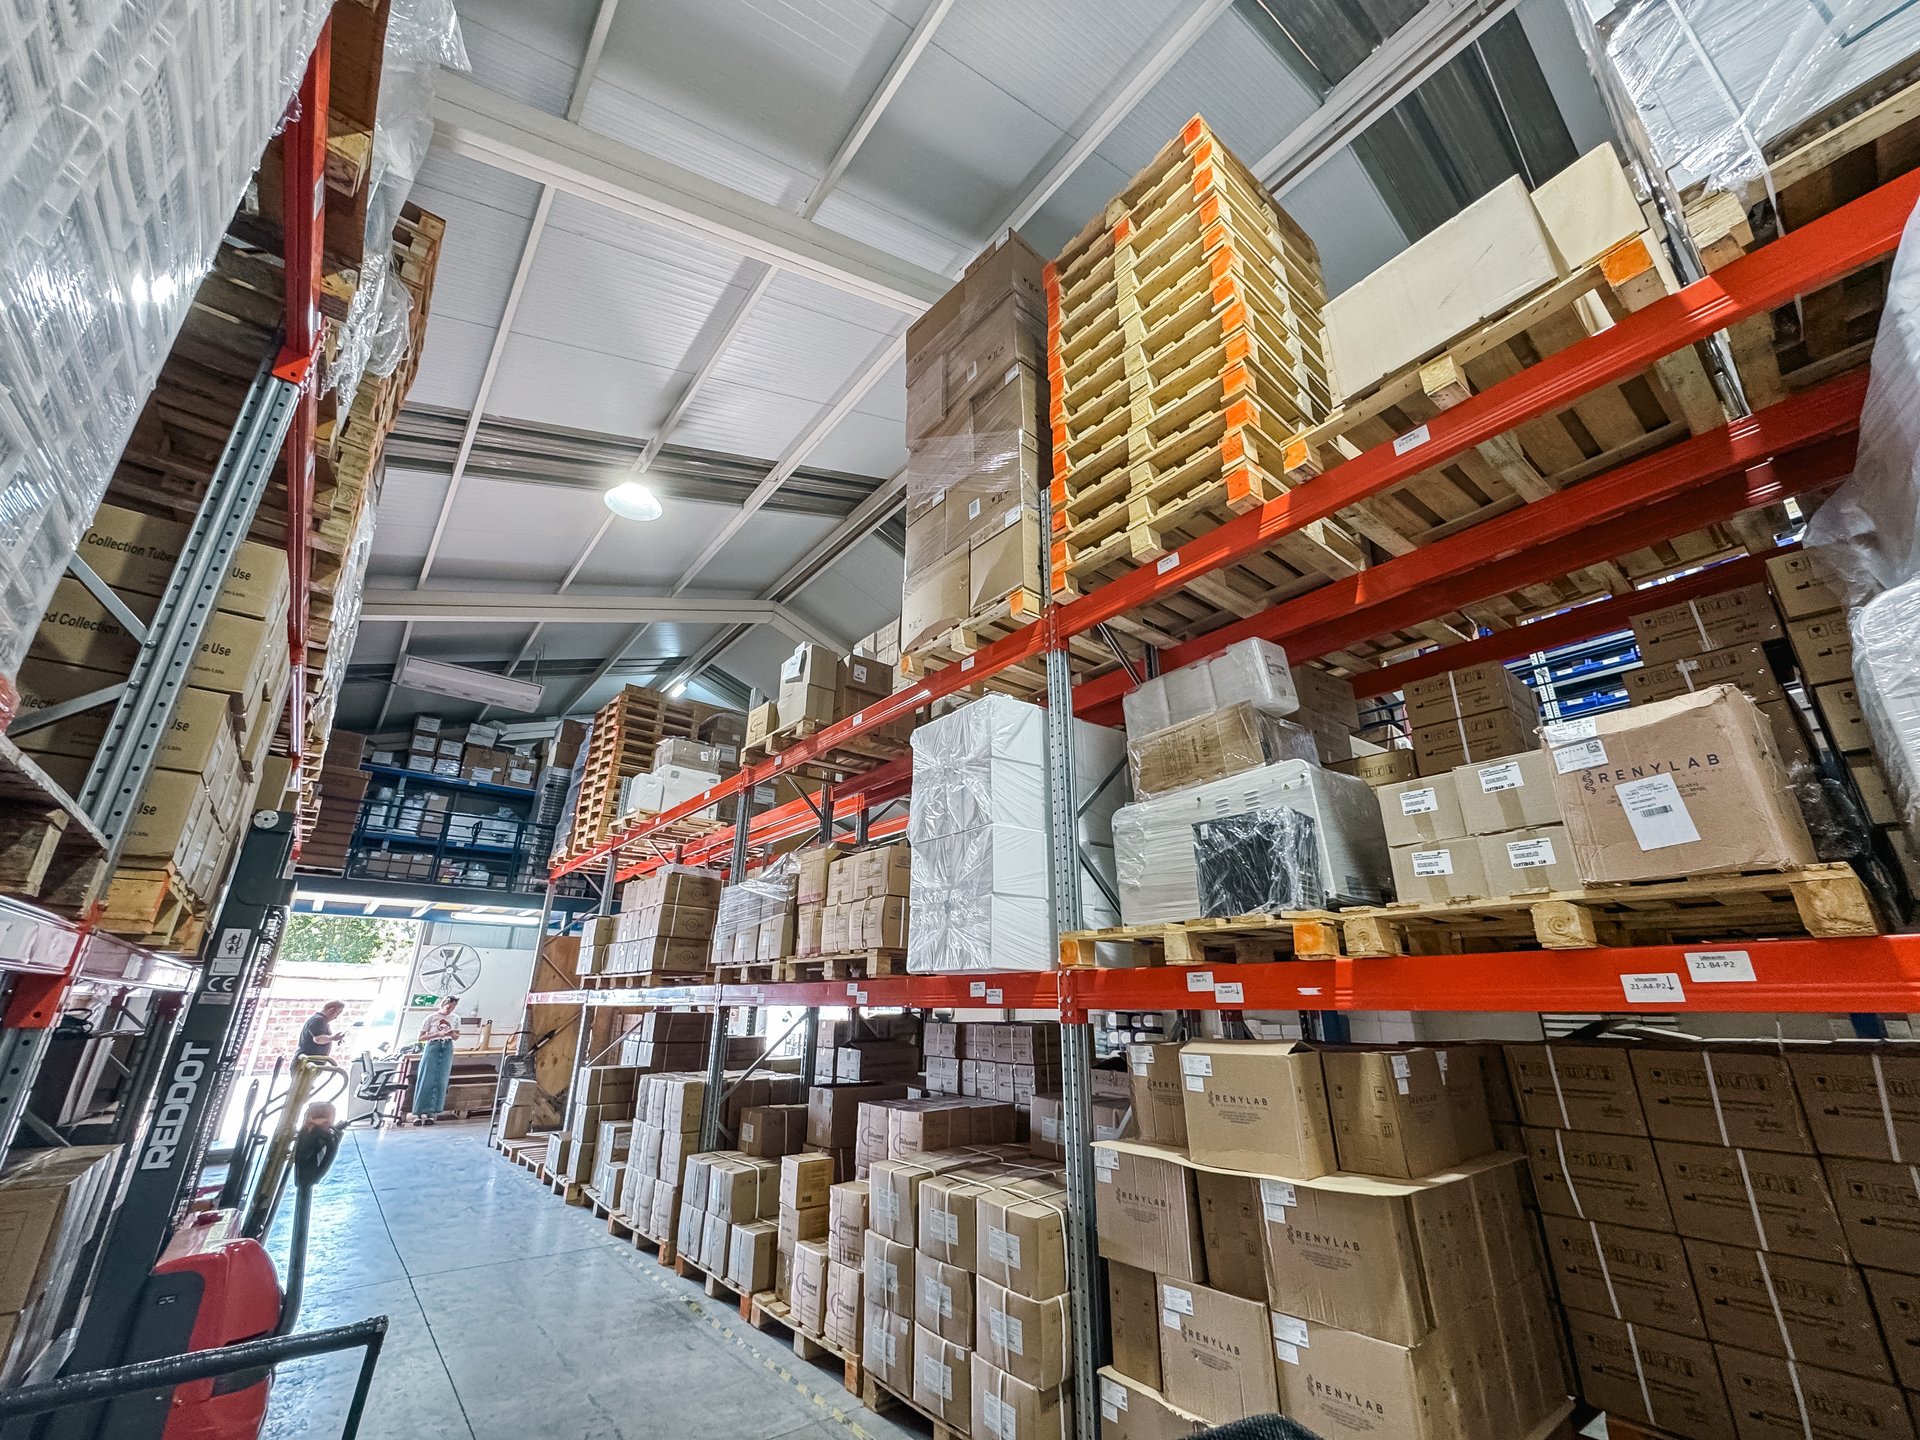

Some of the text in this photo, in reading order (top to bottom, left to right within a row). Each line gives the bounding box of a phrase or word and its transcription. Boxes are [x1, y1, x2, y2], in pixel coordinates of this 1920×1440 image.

[88, 533, 146, 556] Collection
[232, 567, 252, 581] Use
[60, 613, 119, 635] Collection
[211, 643, 232, 657] Use
[1598, 753, 1720, 784] RENYLAB
[207, 976, 236, 992] CE
[1152, 1080, 1182, 1090] RENYL
[141, 1042, 211, 1170] REDDOT
[1215, 1094, 1268, 1106] RENYLAB
[1121, 1191, 1166, 1208] RENYLAB
[1296, 1230, 1360, 1251] RENYLAB
[1188, 1328, 1241, 1356] RENYLAB
[1316, 1381, 1384, 1414] RENYLAB
